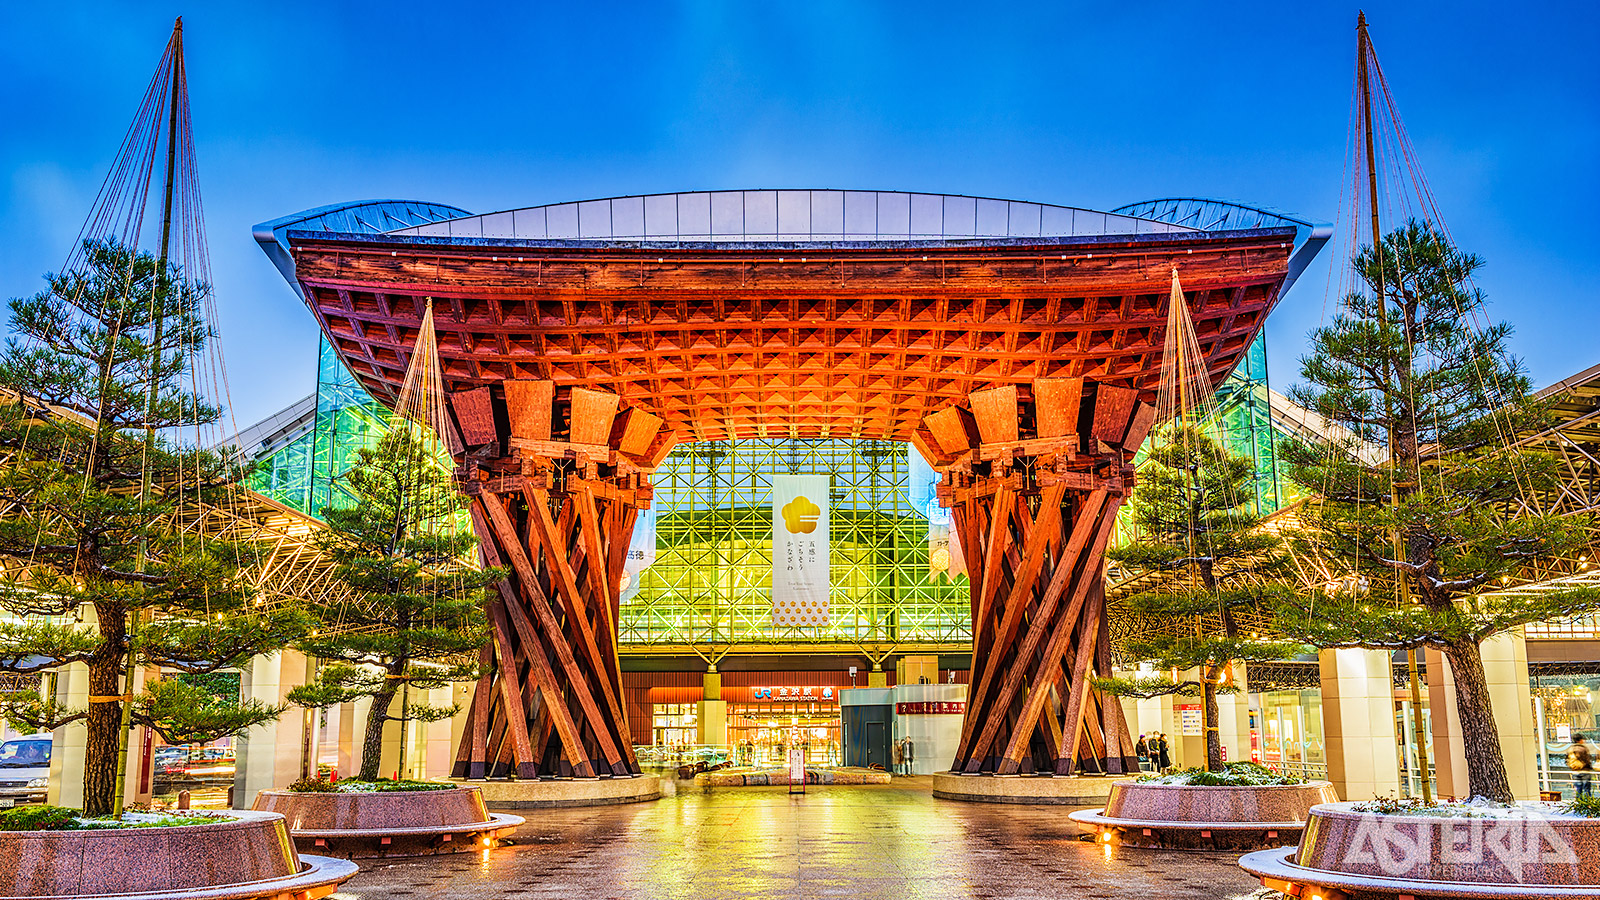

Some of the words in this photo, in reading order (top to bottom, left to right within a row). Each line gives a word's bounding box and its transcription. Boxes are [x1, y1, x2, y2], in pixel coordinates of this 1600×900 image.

[808, 540, 816, 563] 五感に
[755, 689, 771, 698] JR
[779, 687, 812, 697] 金沢駅
